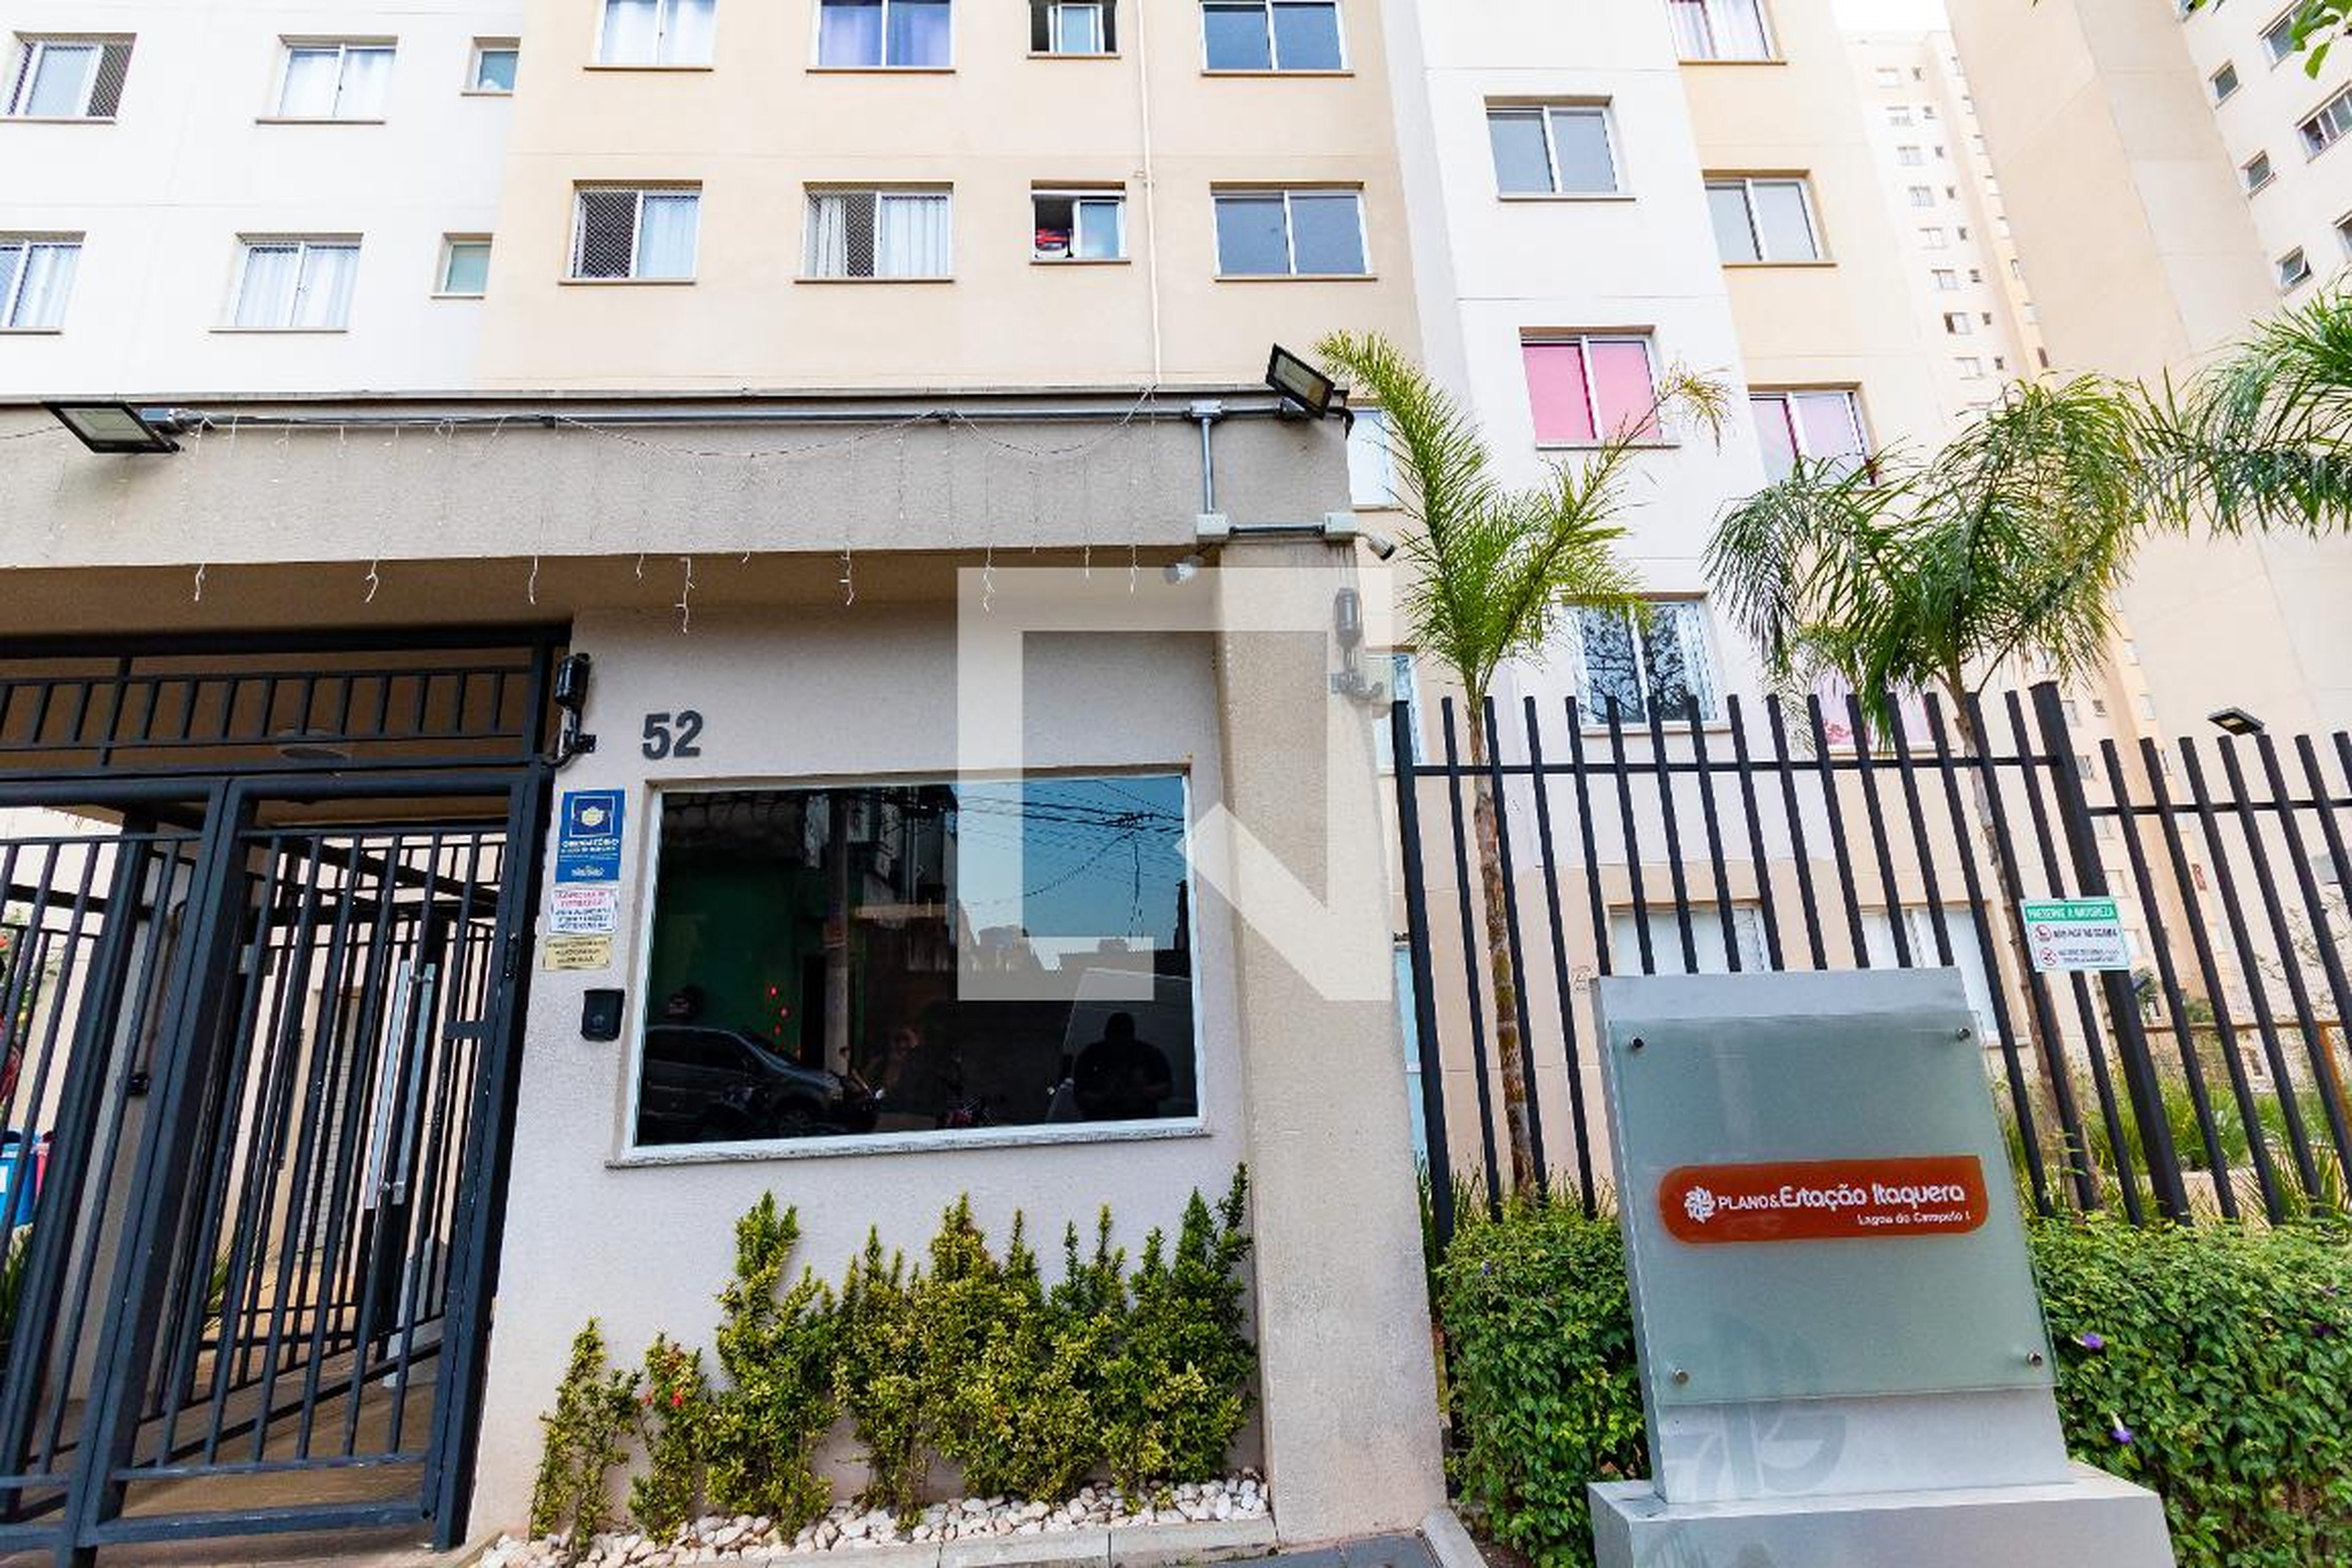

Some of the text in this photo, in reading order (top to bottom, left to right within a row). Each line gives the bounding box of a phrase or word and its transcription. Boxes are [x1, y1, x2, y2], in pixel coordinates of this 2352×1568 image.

[642, 710, 704, 760] 52
[1872, 1183, 1966, 1209] Itaquera
[1857, 1213, 1894, 1226] Lagoa
[1895, 1213, 1912, 1224] do
